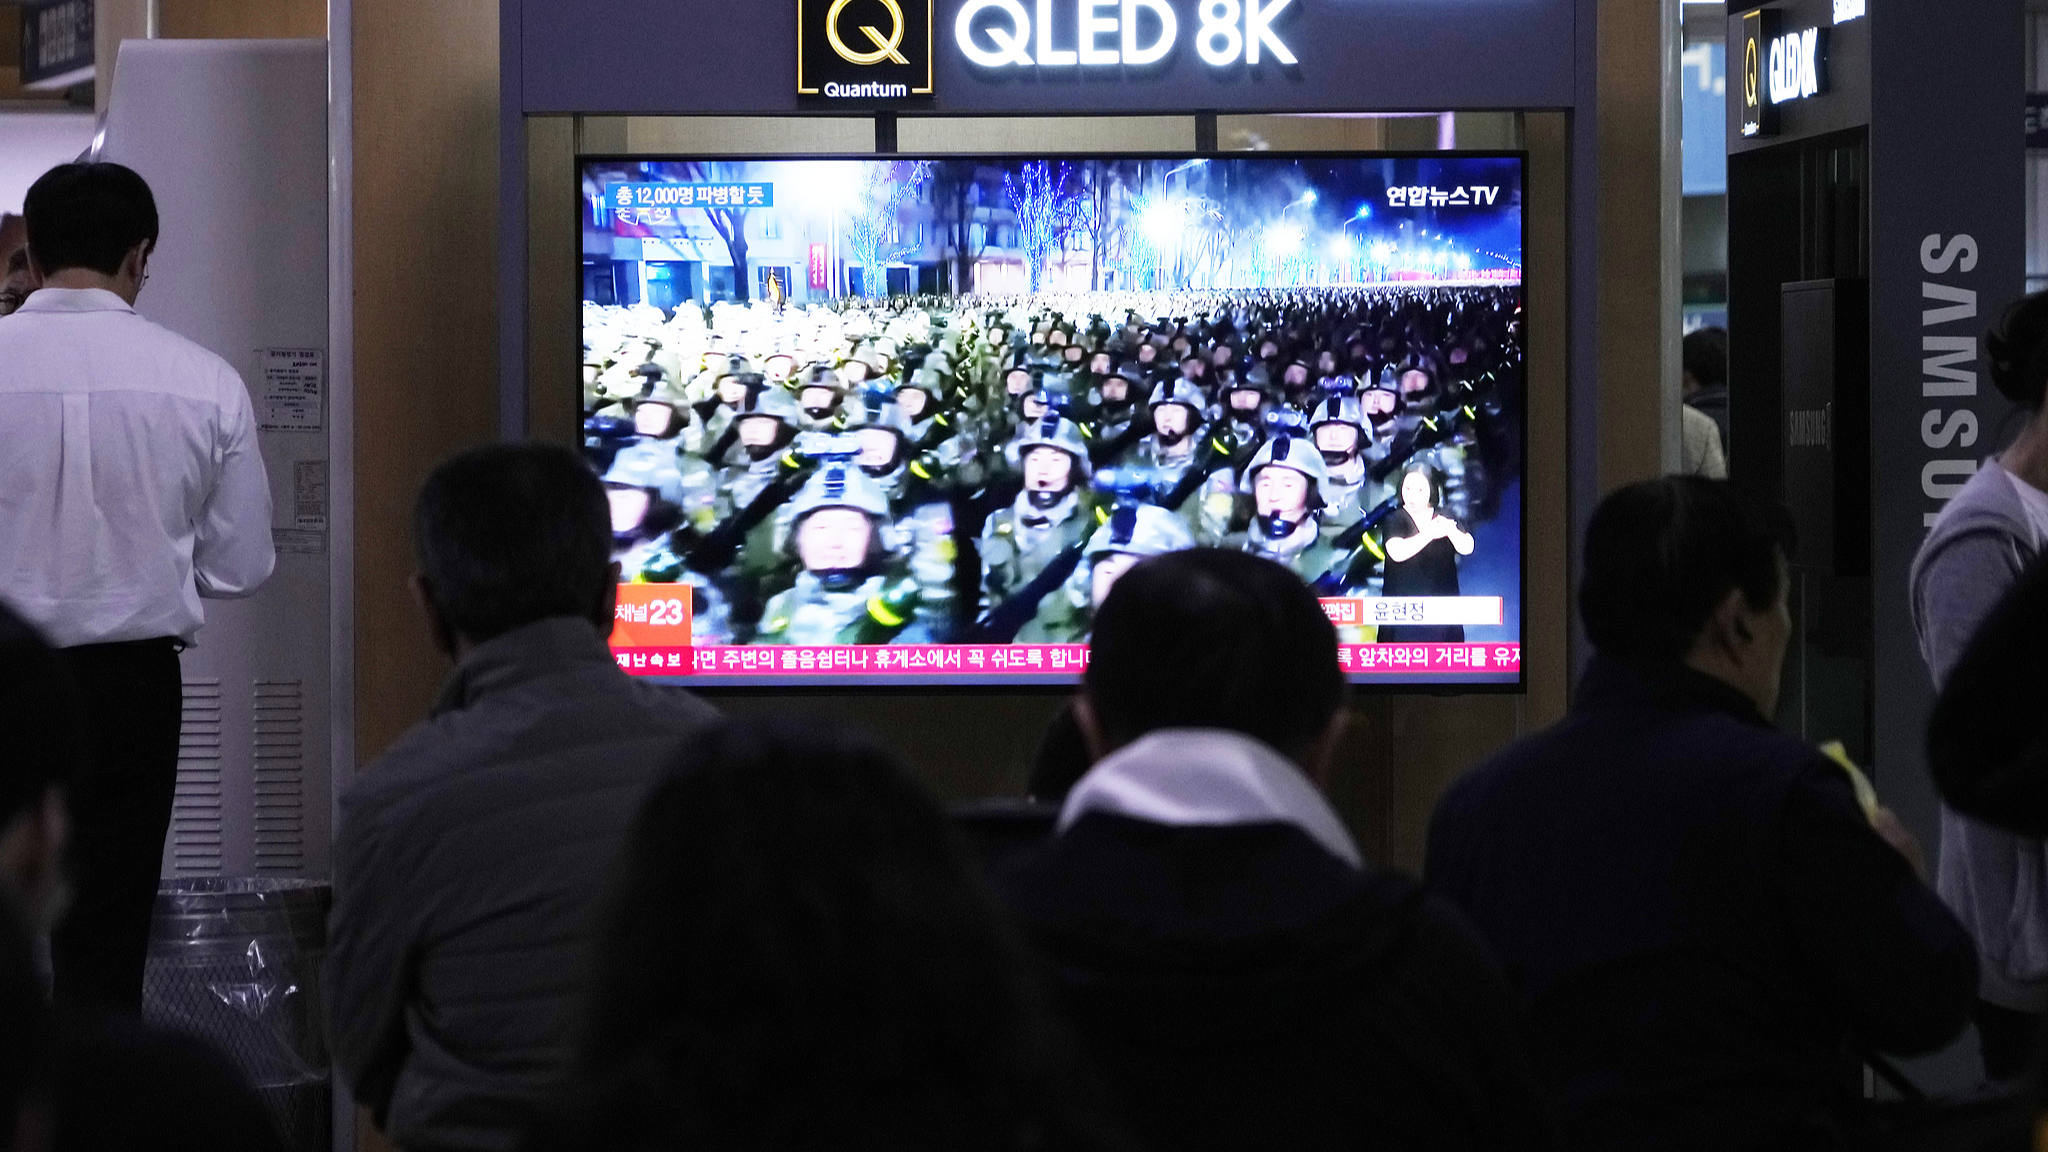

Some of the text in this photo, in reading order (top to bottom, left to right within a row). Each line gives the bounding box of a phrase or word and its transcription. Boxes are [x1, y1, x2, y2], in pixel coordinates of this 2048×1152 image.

[955, 0, 1299, 67] QLED 8K
[1769, 32, 1801, 105] QLED
[823, 81, 908, 98] Quantum
[615, 185, 765, 207] 총 12,000명 파병할 듯
[1386, 185, 1500, 207] 연합뉴스TV
[1920, 233, 1979, 527] SAMSU
[1790, 409, 1826, 447] SAMSUNG
[615, 599, 684, 625] 채널 23
[1320, 602, 1356, 621] 편집
[1374, 602, 1424, 622] 윤현정
[616, 653, 681, 668] 재난속보
[692, 650, 717, 669] 면
[722, 650, 775, 669] 주변의
[780, 649, 868, 670] 졸음쉼터나
[874, 649, 962, 669] 휴게소에서
[967, 650, 986, 669] 꼭
[991, 649, 1044, 669] 쉬도록
[1359, 648, 1429, 667] 앞차와의
[1435, 648, 1488, 667] 거리를
